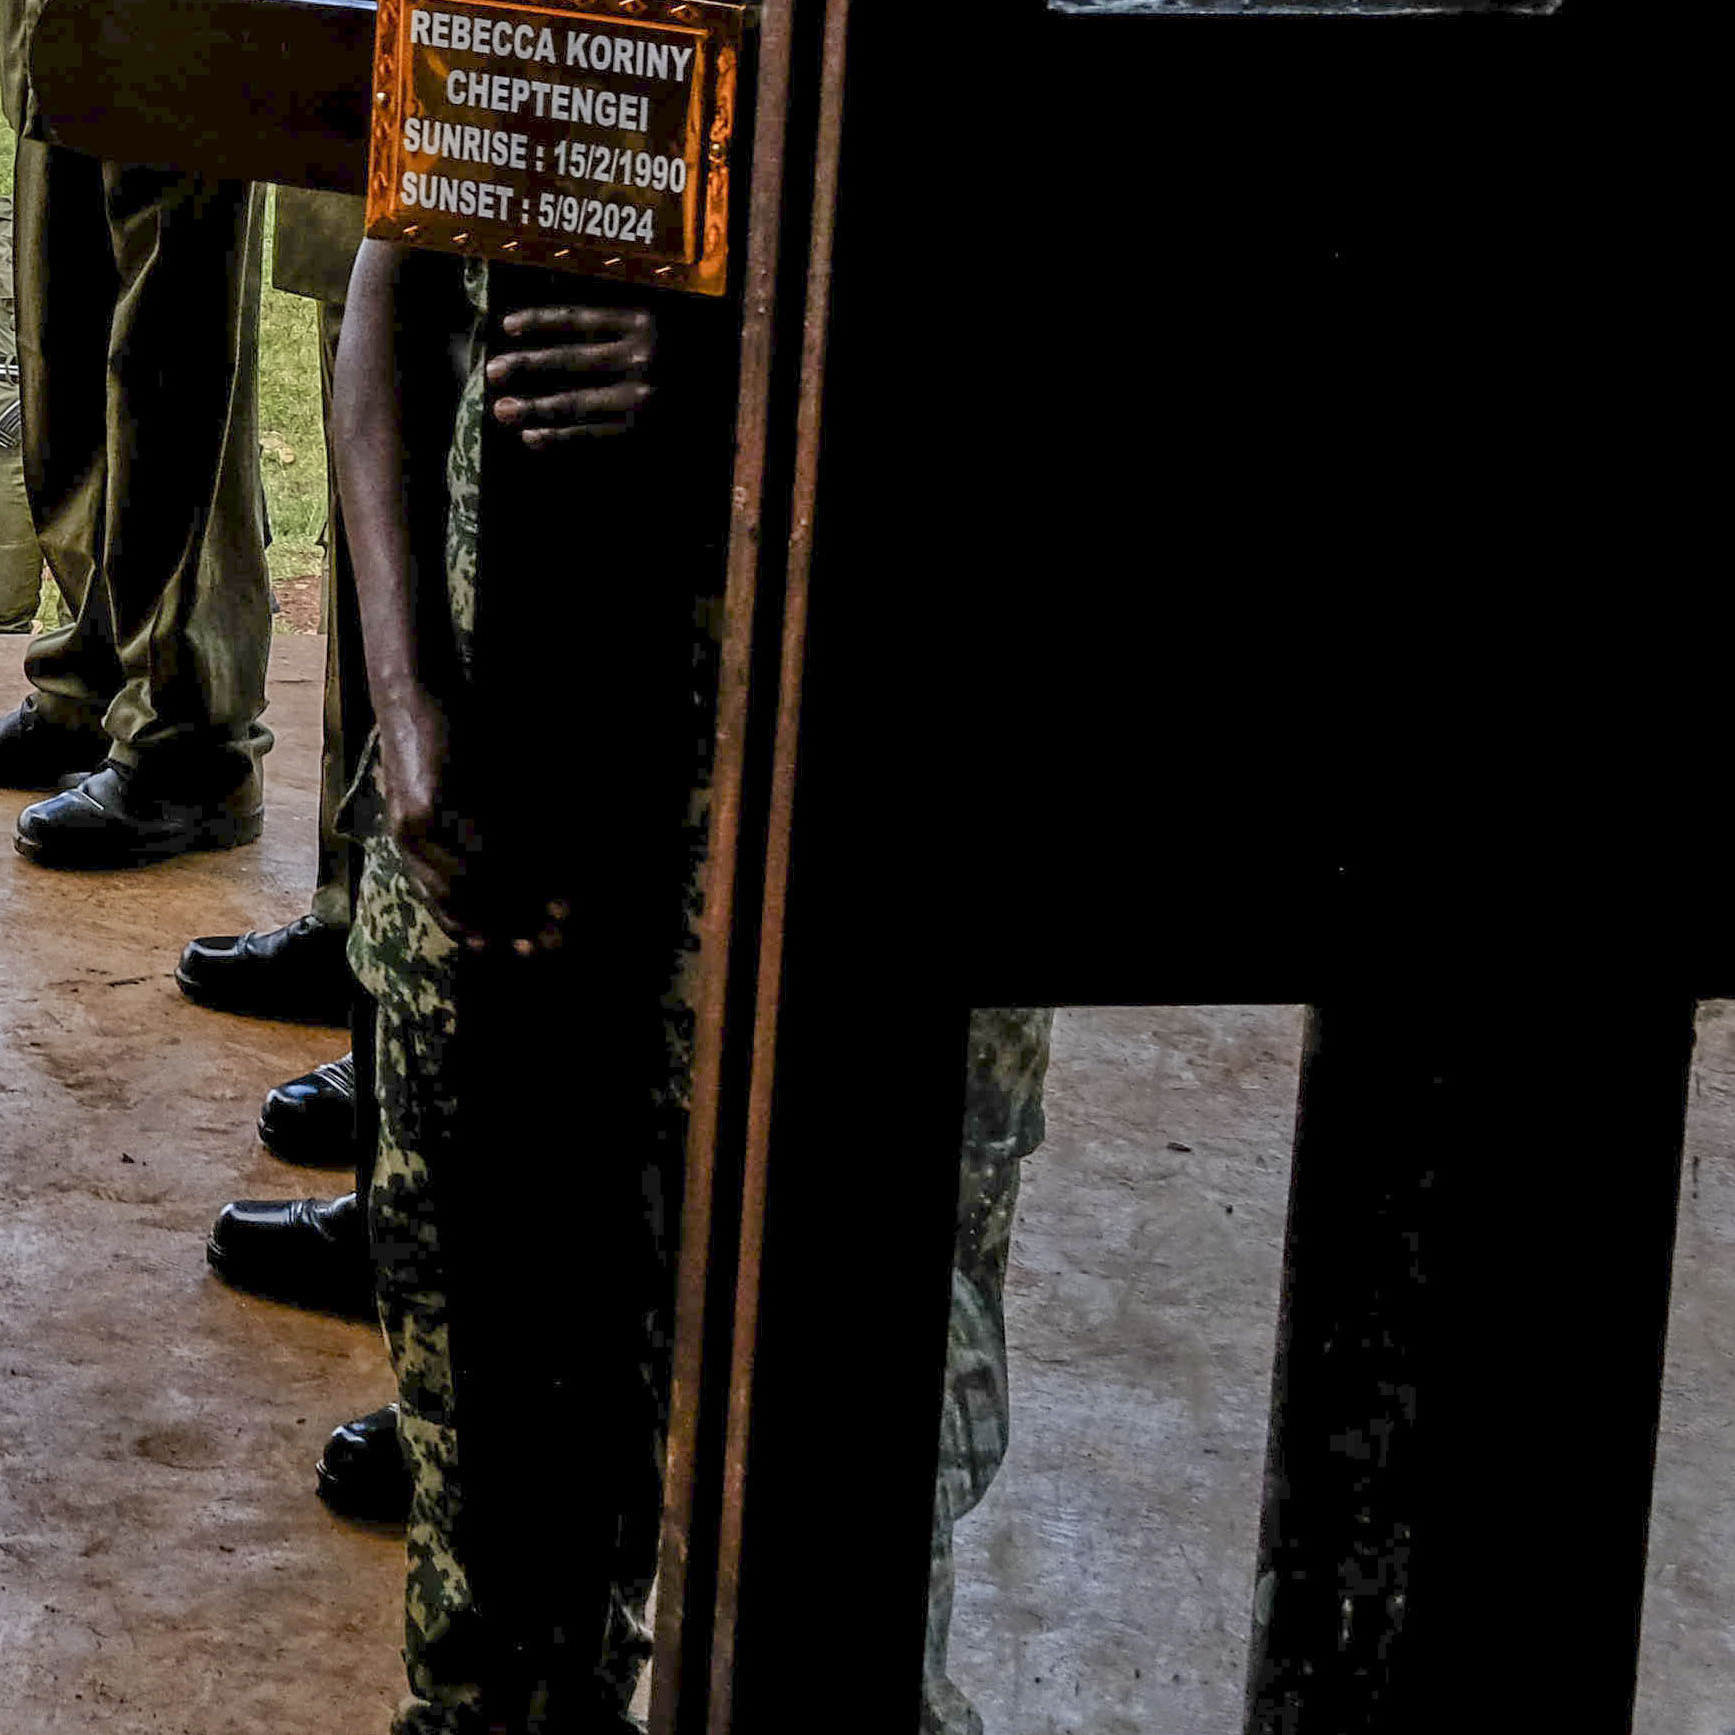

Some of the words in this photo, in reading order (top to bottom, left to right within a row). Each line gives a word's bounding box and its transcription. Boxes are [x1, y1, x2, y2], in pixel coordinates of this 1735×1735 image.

[410, 9, 556, 64] REBECCA
[566, 30, 694, 82] KORINY
[446, 69, 650, 133] CHEPTENGEI
[403, 117, 528, 170] SUNRISE
[554, 140, 687, 194] 15/2/1990
[400, 171, 514, 222] SUNSET
[538, 192, 654, 244] 5/9/2024
